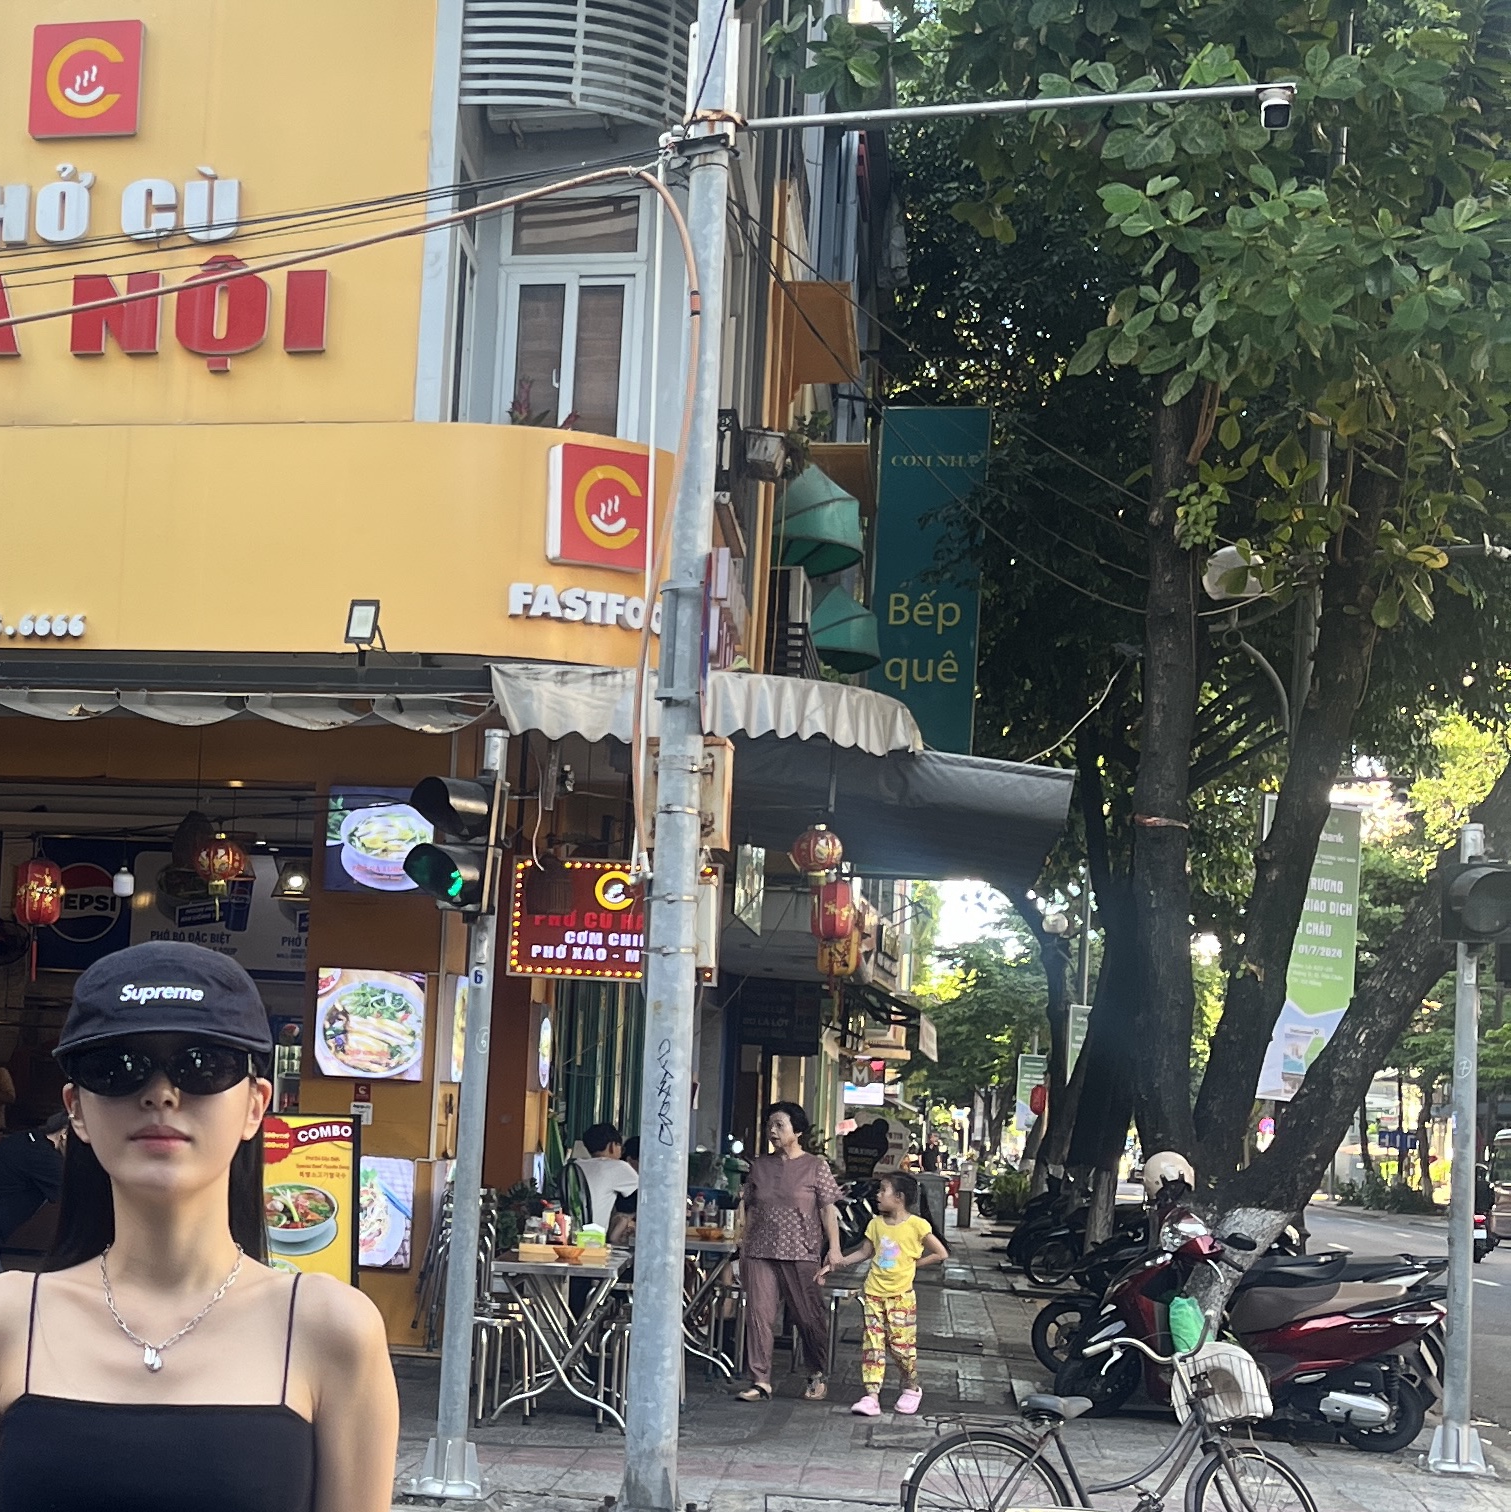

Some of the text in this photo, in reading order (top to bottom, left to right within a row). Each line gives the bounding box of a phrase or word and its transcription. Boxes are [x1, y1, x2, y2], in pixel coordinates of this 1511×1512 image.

[120, 166, 242, 244] CÙ
[69, 255, 329, 371] NỘI
[888, 590, 961, 635] Bếp
[884, 650, 959, 690] quê
[63, 893, 117, 912] EPSI
[564, 930, 604, 946] CƠM
[531, 944, 568, 959] PHỞ
[571, 946, 608, 961] XÀO
[473, 969, 483, 984] 6
[119, 984, 205, 1005] Supreme
[297, 1124, 353, 1143] COMBO
